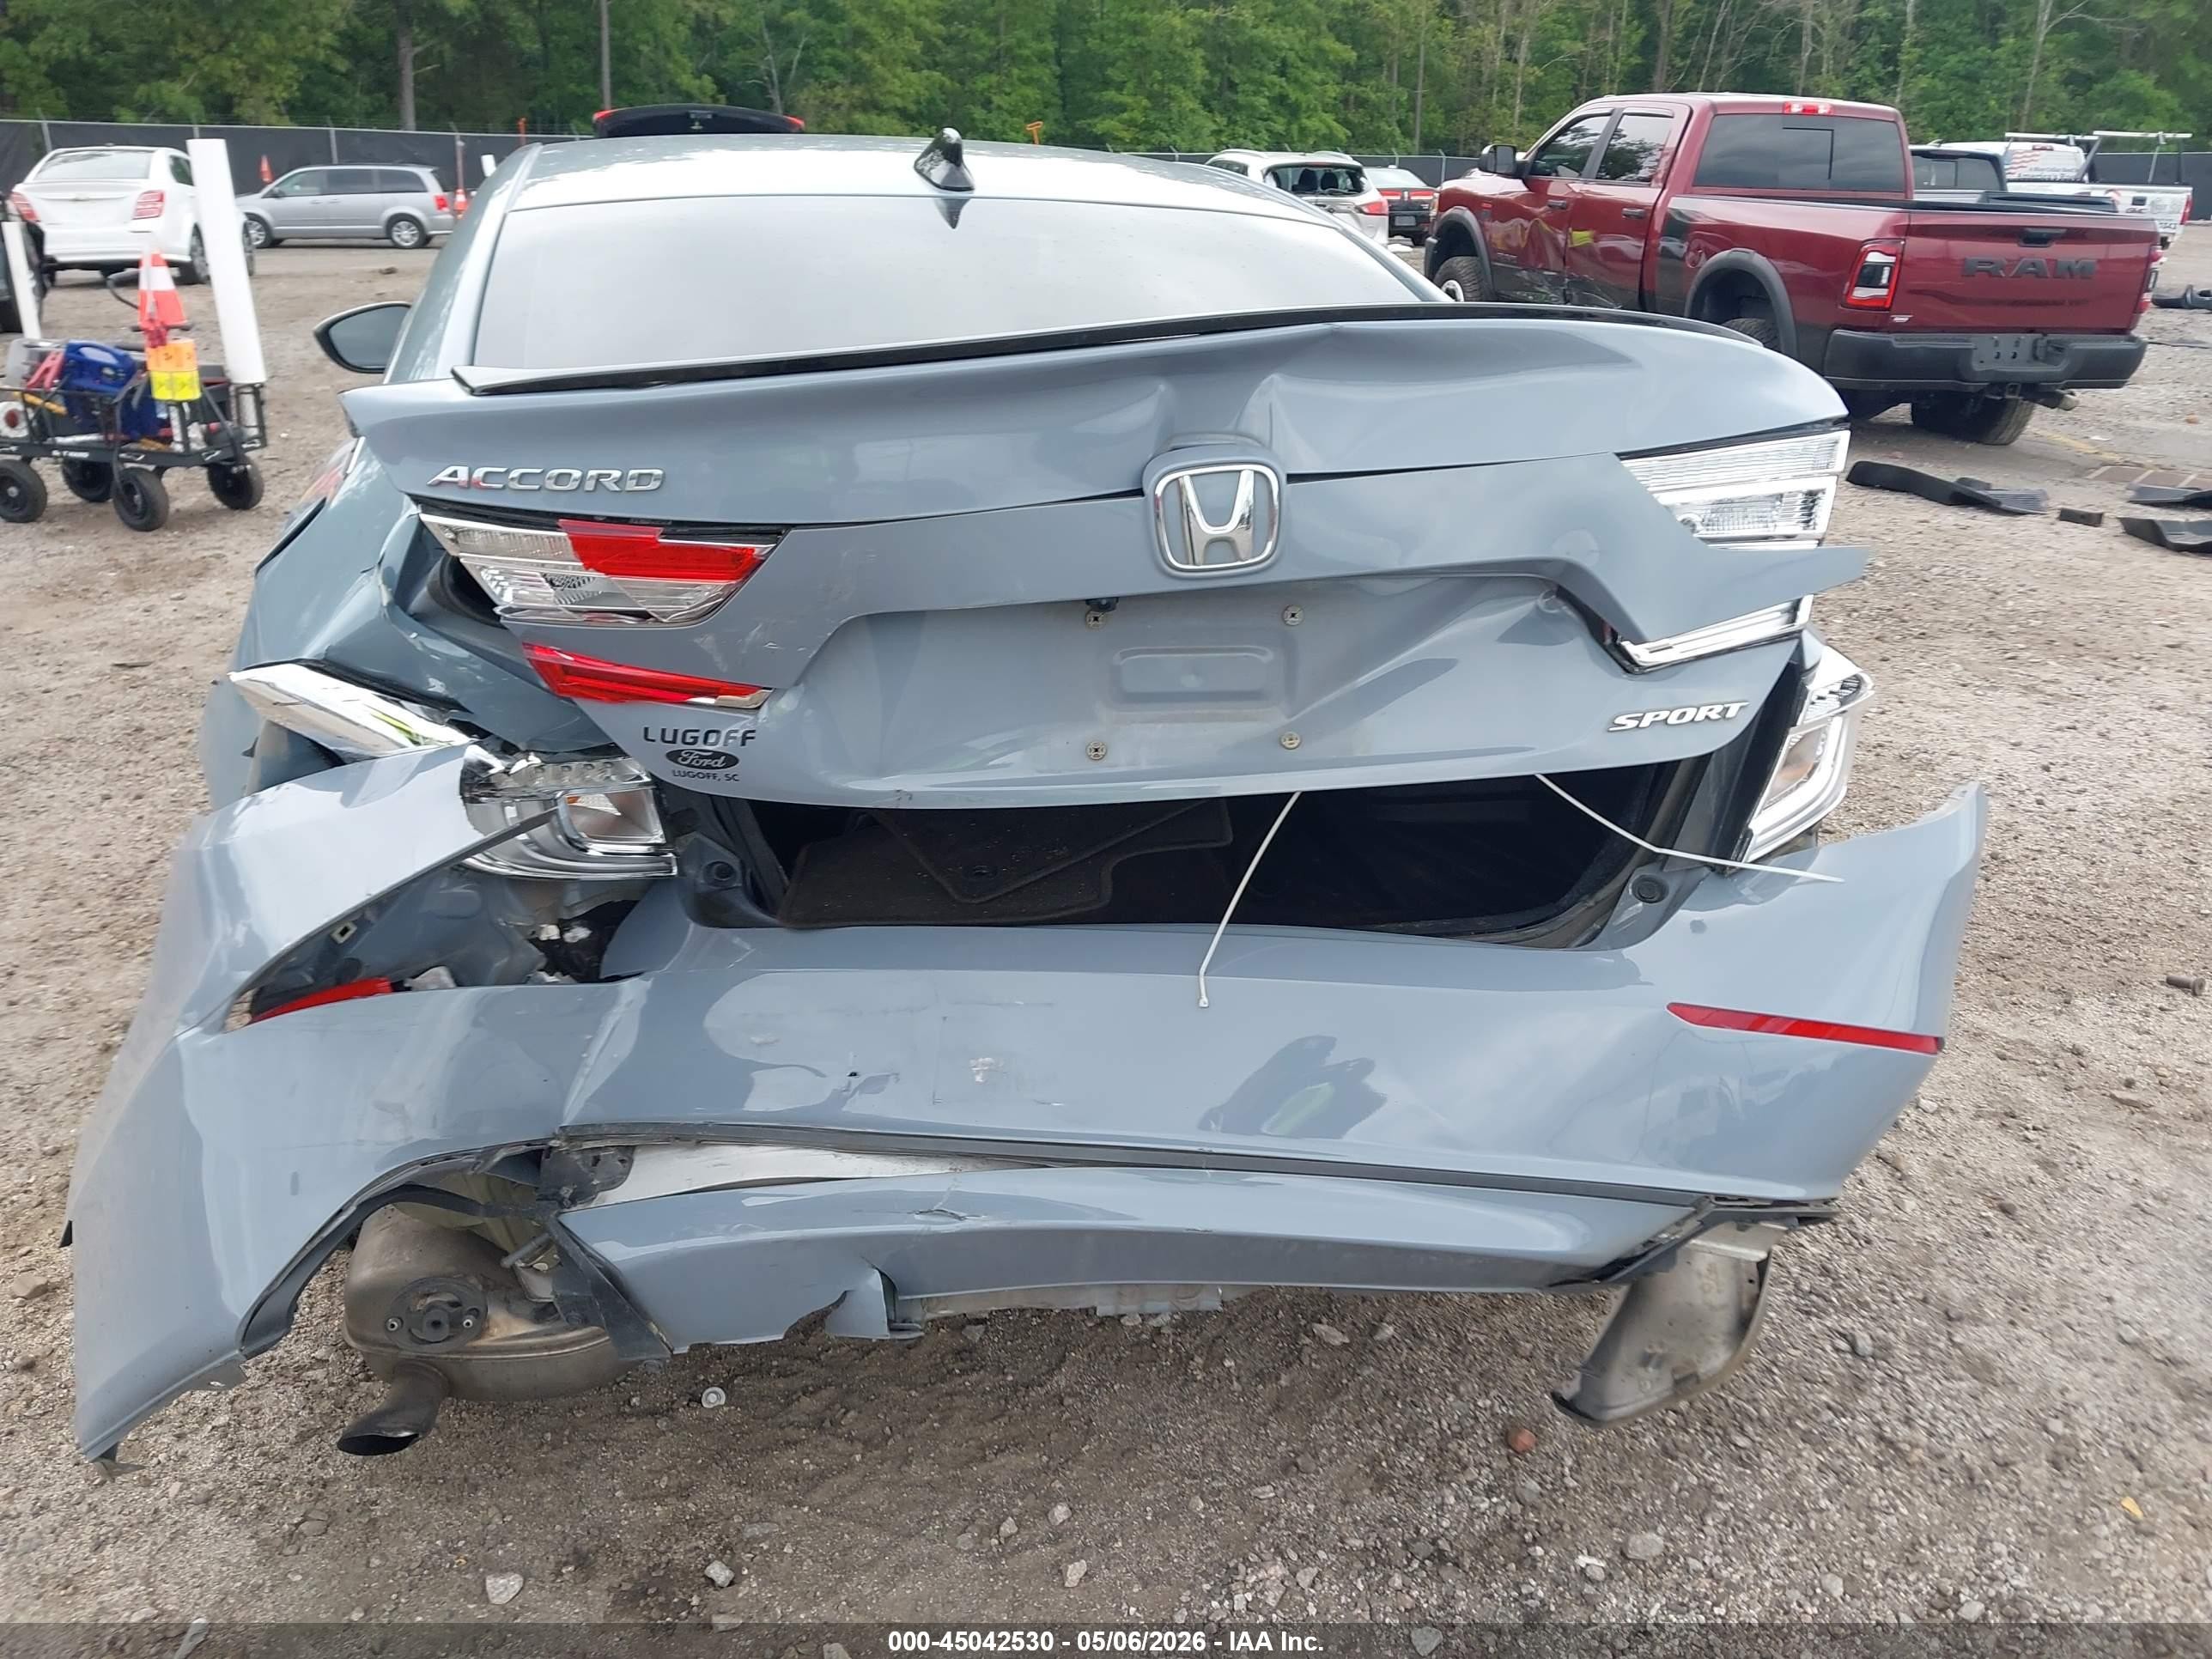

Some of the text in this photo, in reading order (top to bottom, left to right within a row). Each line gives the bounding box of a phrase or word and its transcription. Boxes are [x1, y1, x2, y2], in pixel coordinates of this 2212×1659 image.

[1962, 257, 2097, 279] RAM
[427, 465, 665, 492] ACCORD
[1607, 701, 1751, 732] SPORT
[643, 727, 756, 747] LUGOFF
[678, 750, 727, 769] Ford
[673, 770, 721, 781] LUGOFF,
